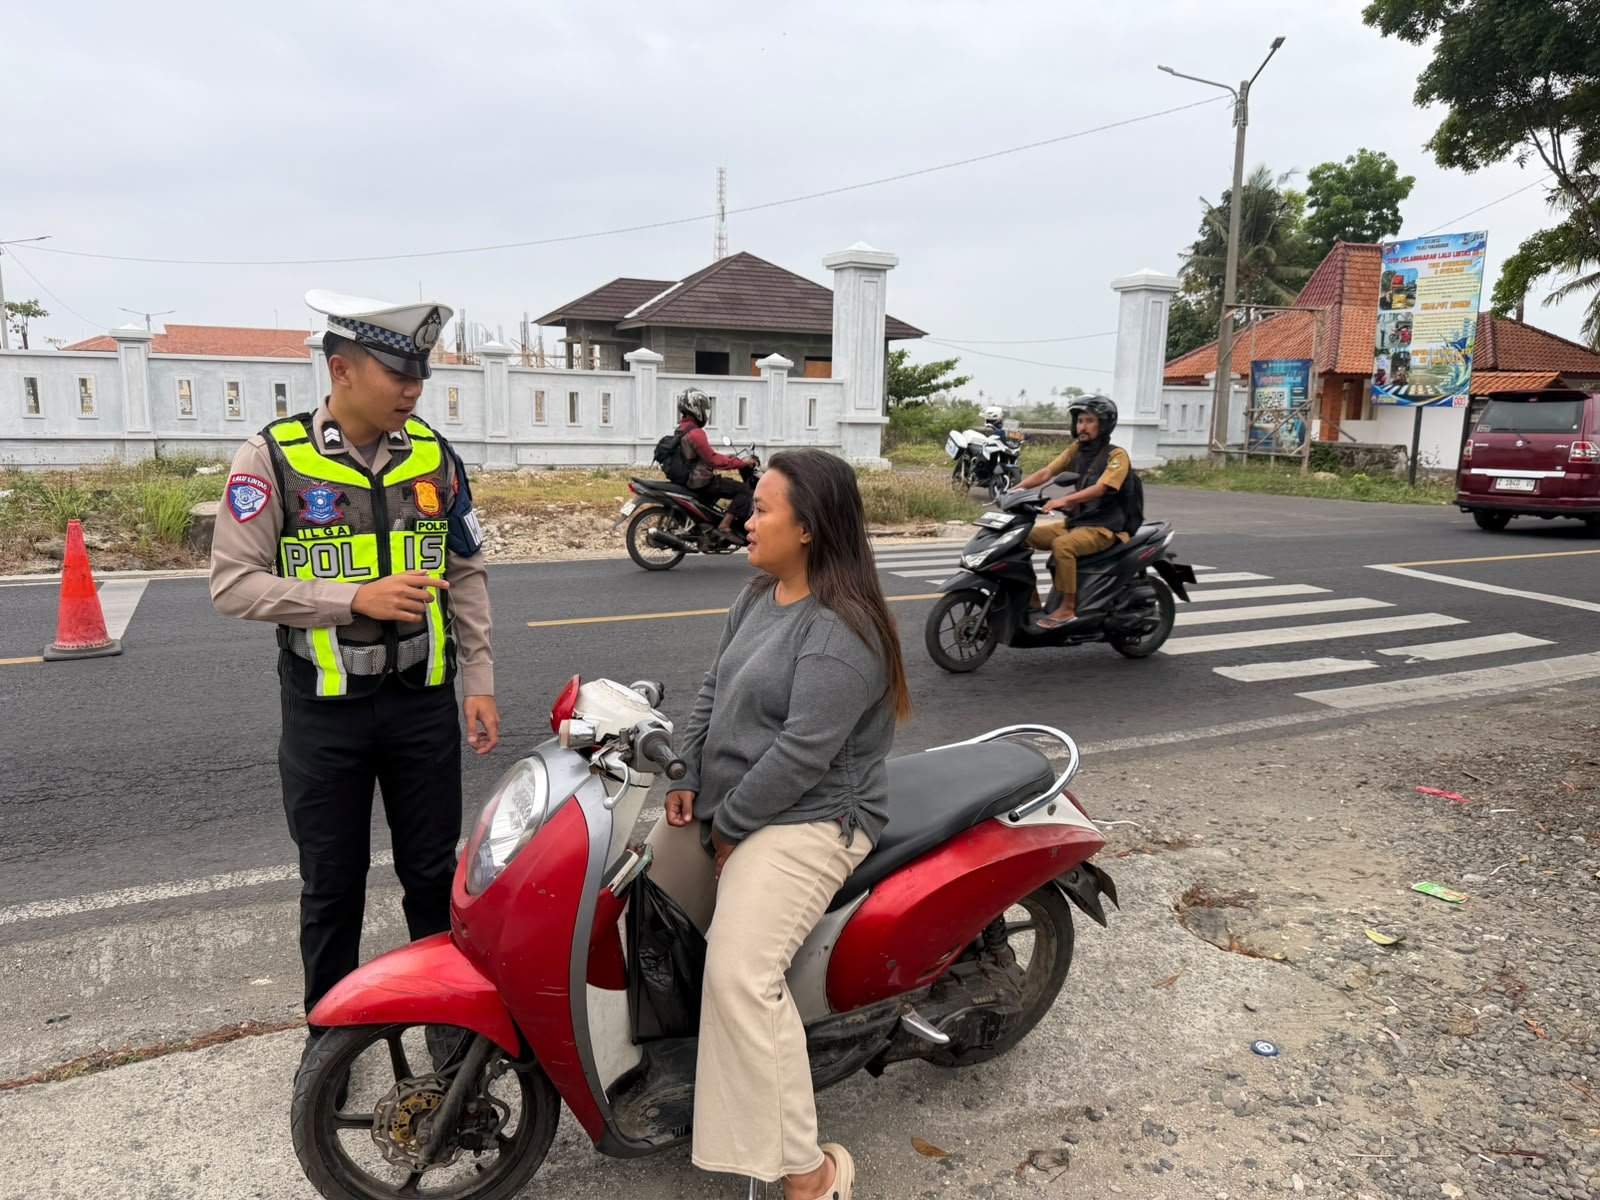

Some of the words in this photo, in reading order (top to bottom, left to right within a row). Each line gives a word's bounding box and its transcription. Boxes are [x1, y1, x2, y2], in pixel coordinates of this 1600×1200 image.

[1438, 252, 1452, 260] LALU
[232, 475, 247, 483] LALU
[247, 477, 268, 490] LINTAS
[418, 521, 447, 531] POLRI
